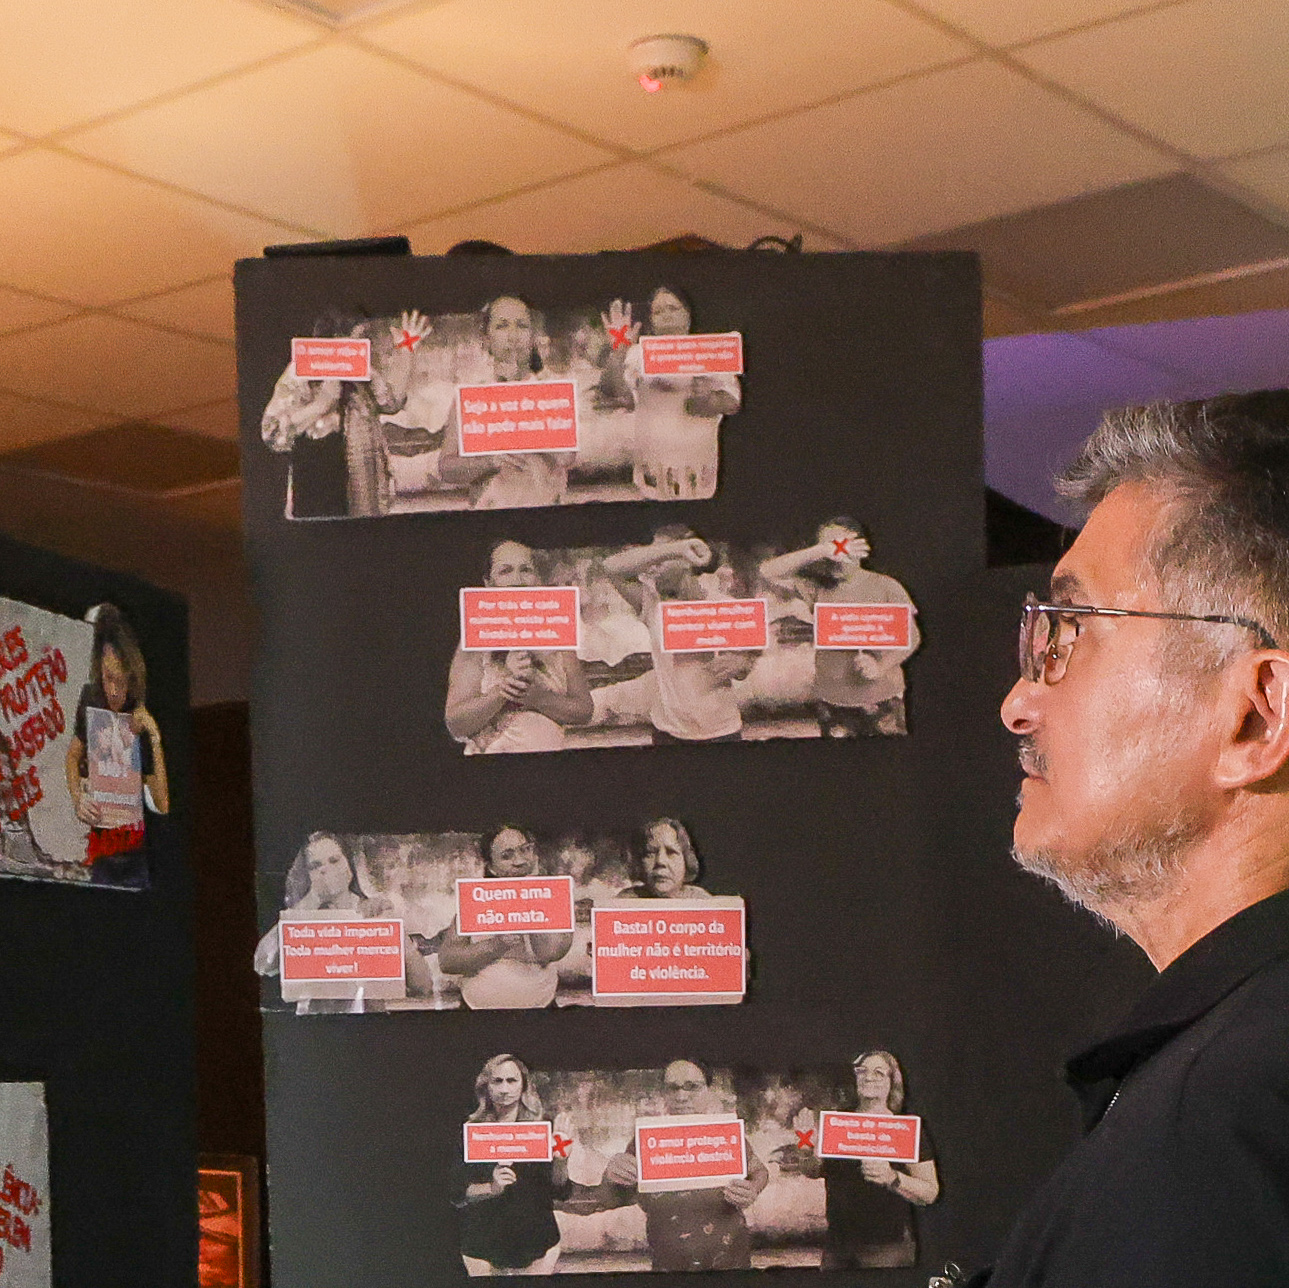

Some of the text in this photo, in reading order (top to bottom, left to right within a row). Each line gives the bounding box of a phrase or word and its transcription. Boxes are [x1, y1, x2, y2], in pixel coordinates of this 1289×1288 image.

[472, 886, 552, 903] Quem ama
[477, 907, 549, 925] não mata.
[613, 919, 725, 937] Basta! O corpo da
[597, 941, 741, 957] mulher não é território
[630, 965, 710, 980] de violência.
